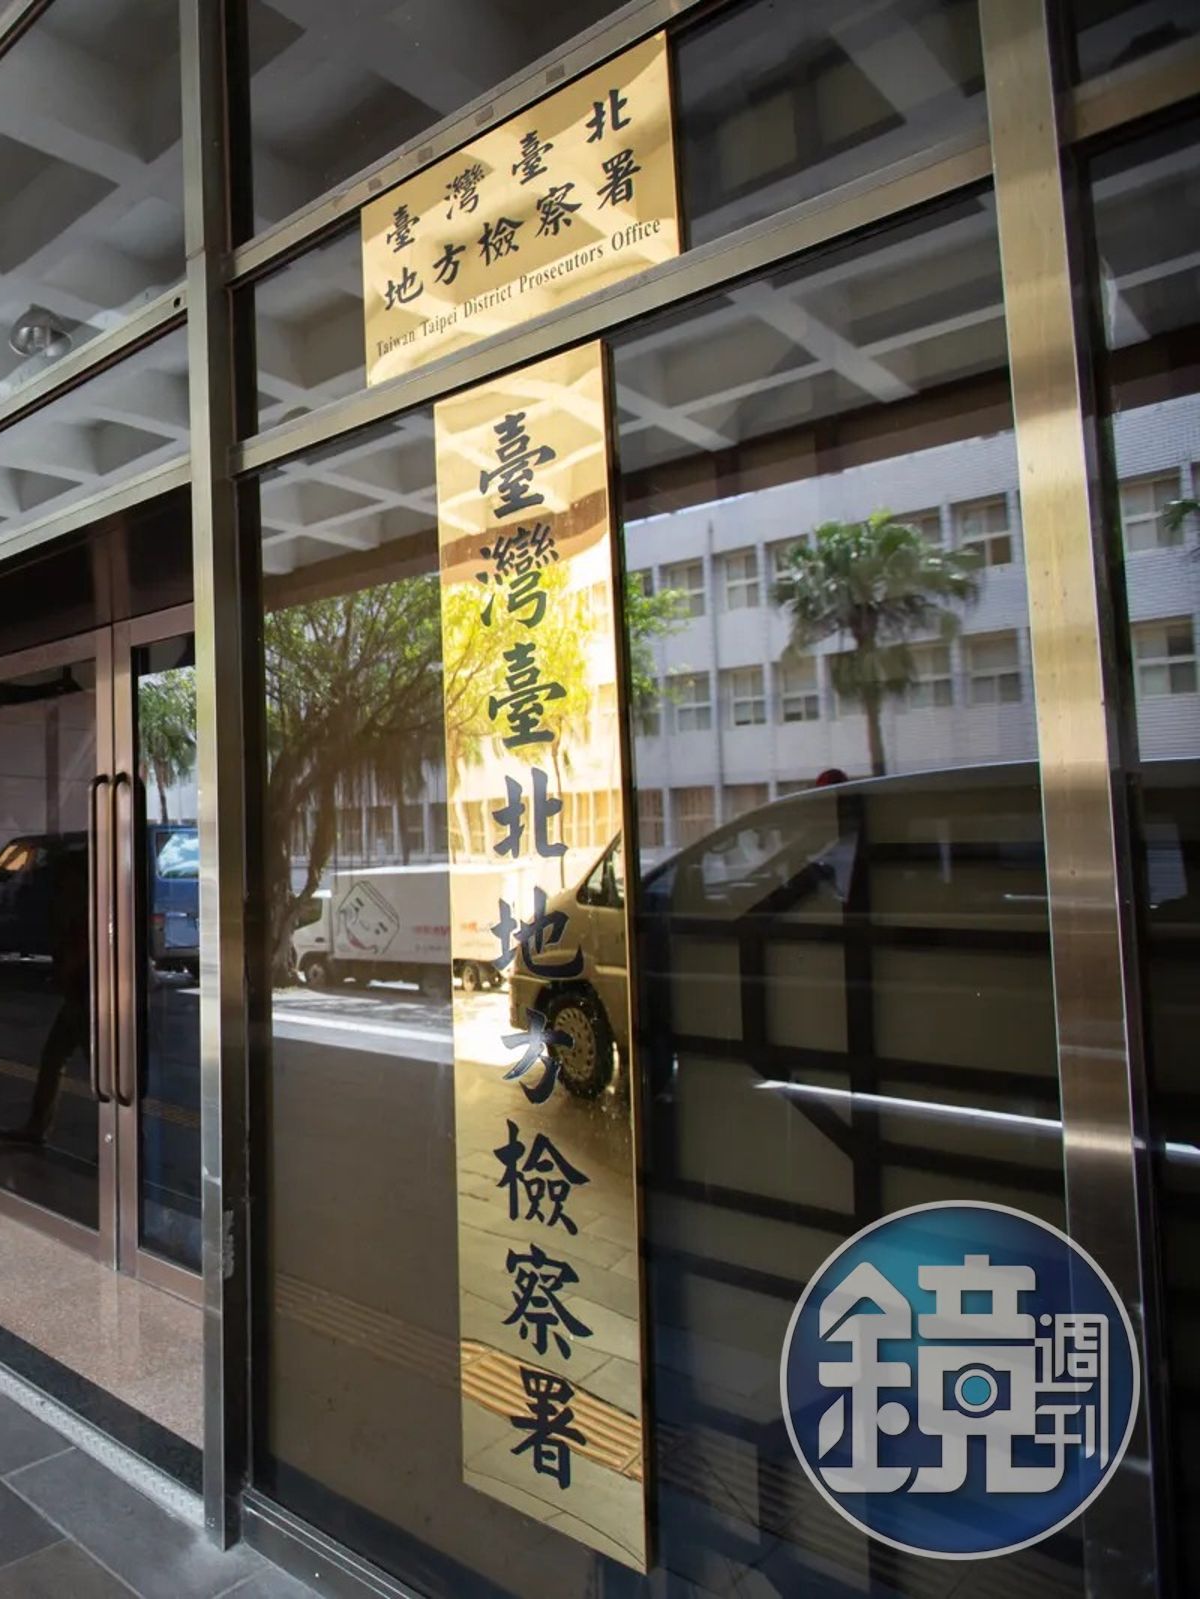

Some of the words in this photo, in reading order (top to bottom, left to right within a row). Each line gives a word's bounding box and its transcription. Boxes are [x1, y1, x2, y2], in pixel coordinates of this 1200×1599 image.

[384, 149, 642, 311] 地方檢察署
[386, 89, 632, 253] 臺灣臺北
[376, 328, 416, 359] Taiwan
[420, 306, 458, 337] Taipei
[463, 285, 513, 319] District
[519, 244, 605, 294] Prosecutors
[611, 218, 661, 252] Office
[477, 411, 593, 1491] 臺灣臺北地方檢察署
